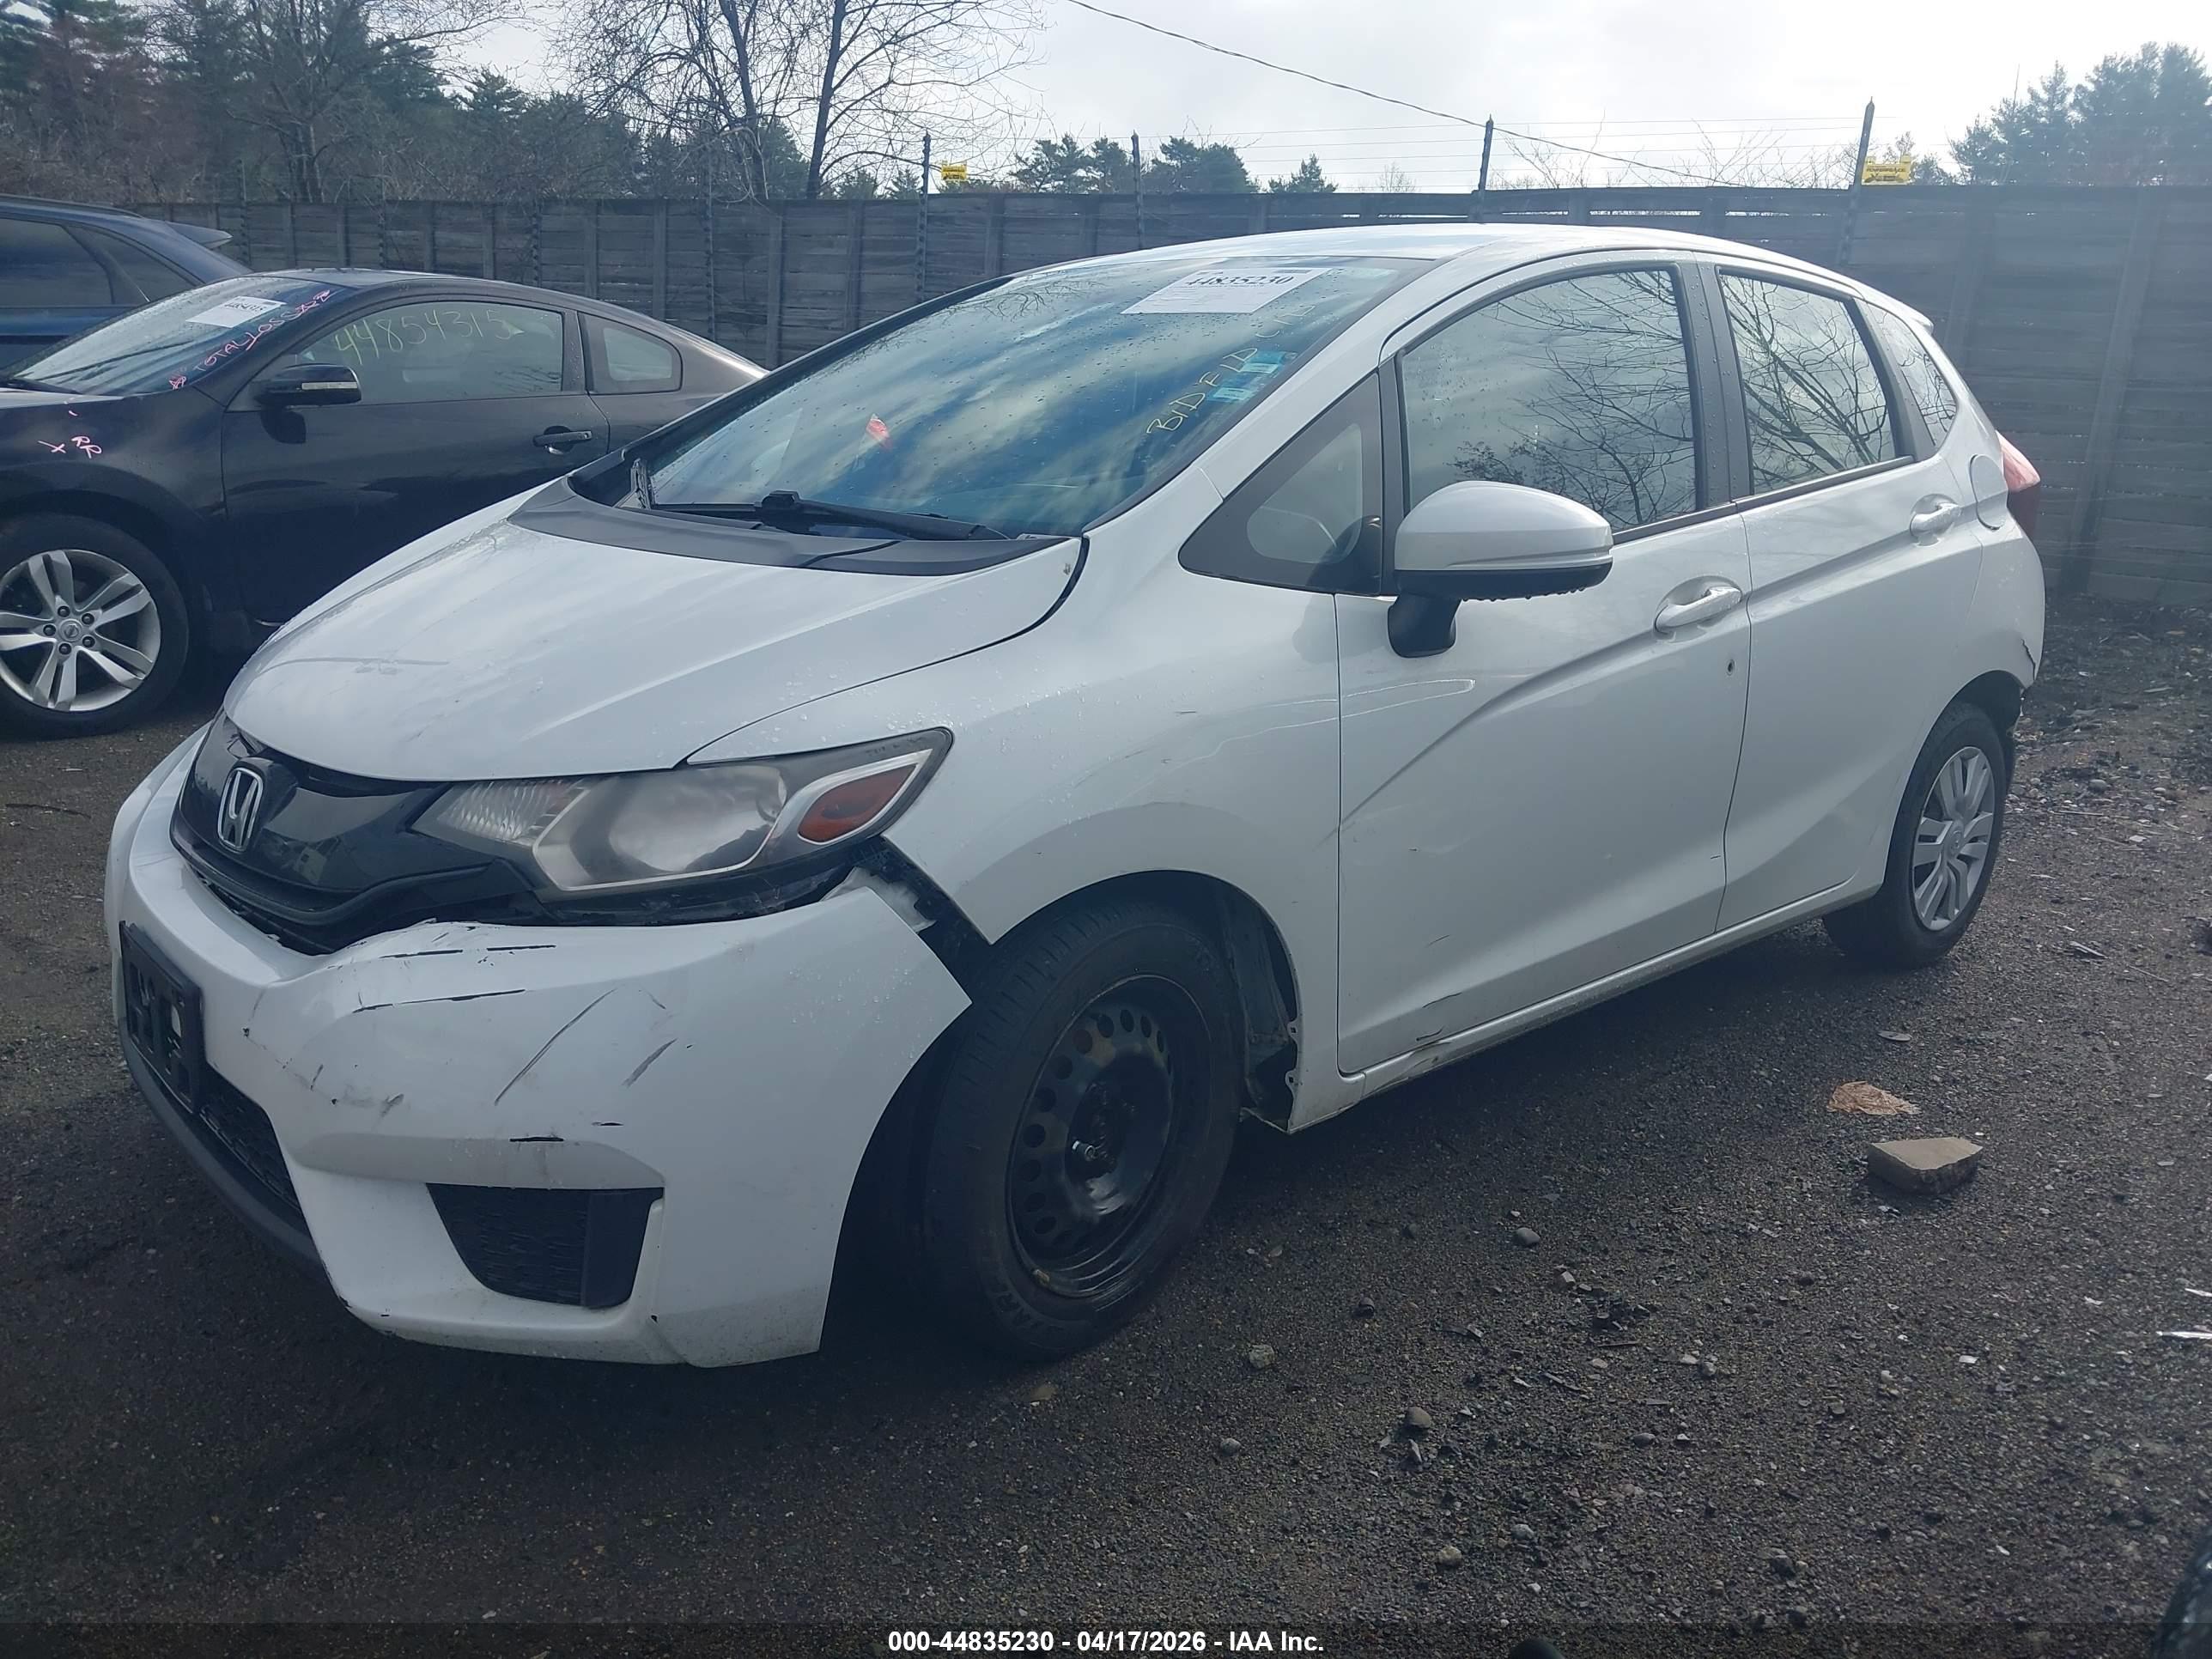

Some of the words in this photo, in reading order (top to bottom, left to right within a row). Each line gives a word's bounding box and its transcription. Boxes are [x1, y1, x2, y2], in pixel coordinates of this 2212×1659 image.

[1185, 275, 1295, 285] 44835230
[193, 337, 251, 373] TOTAL
[334, 308, 513, 366] 44854315
